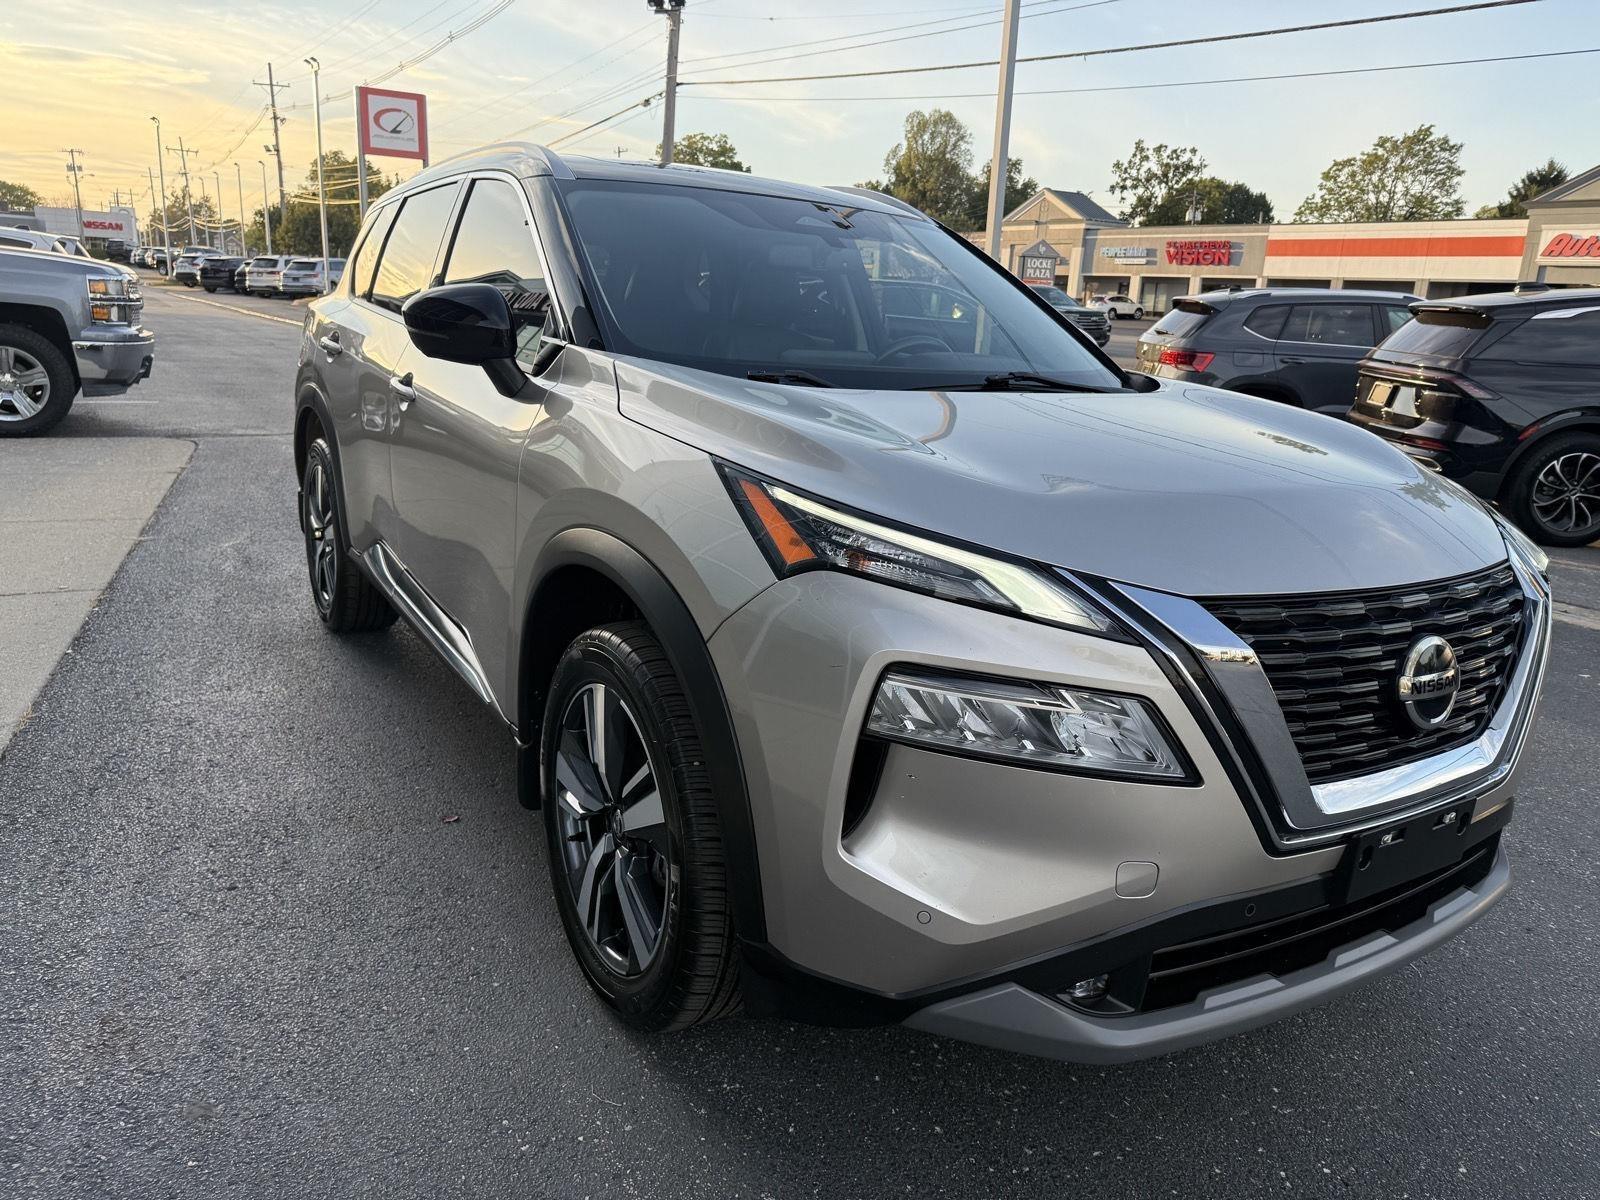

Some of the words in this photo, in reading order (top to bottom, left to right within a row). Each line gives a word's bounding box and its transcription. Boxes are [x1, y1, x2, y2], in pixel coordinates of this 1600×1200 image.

[1166, 249, 1230, 265] VISION
[1027, 259, 1052, 269] LOCKE
[1026, 268, 1050, 278] PLAZA
[1411, 675, 1455, 695] NISSAN
